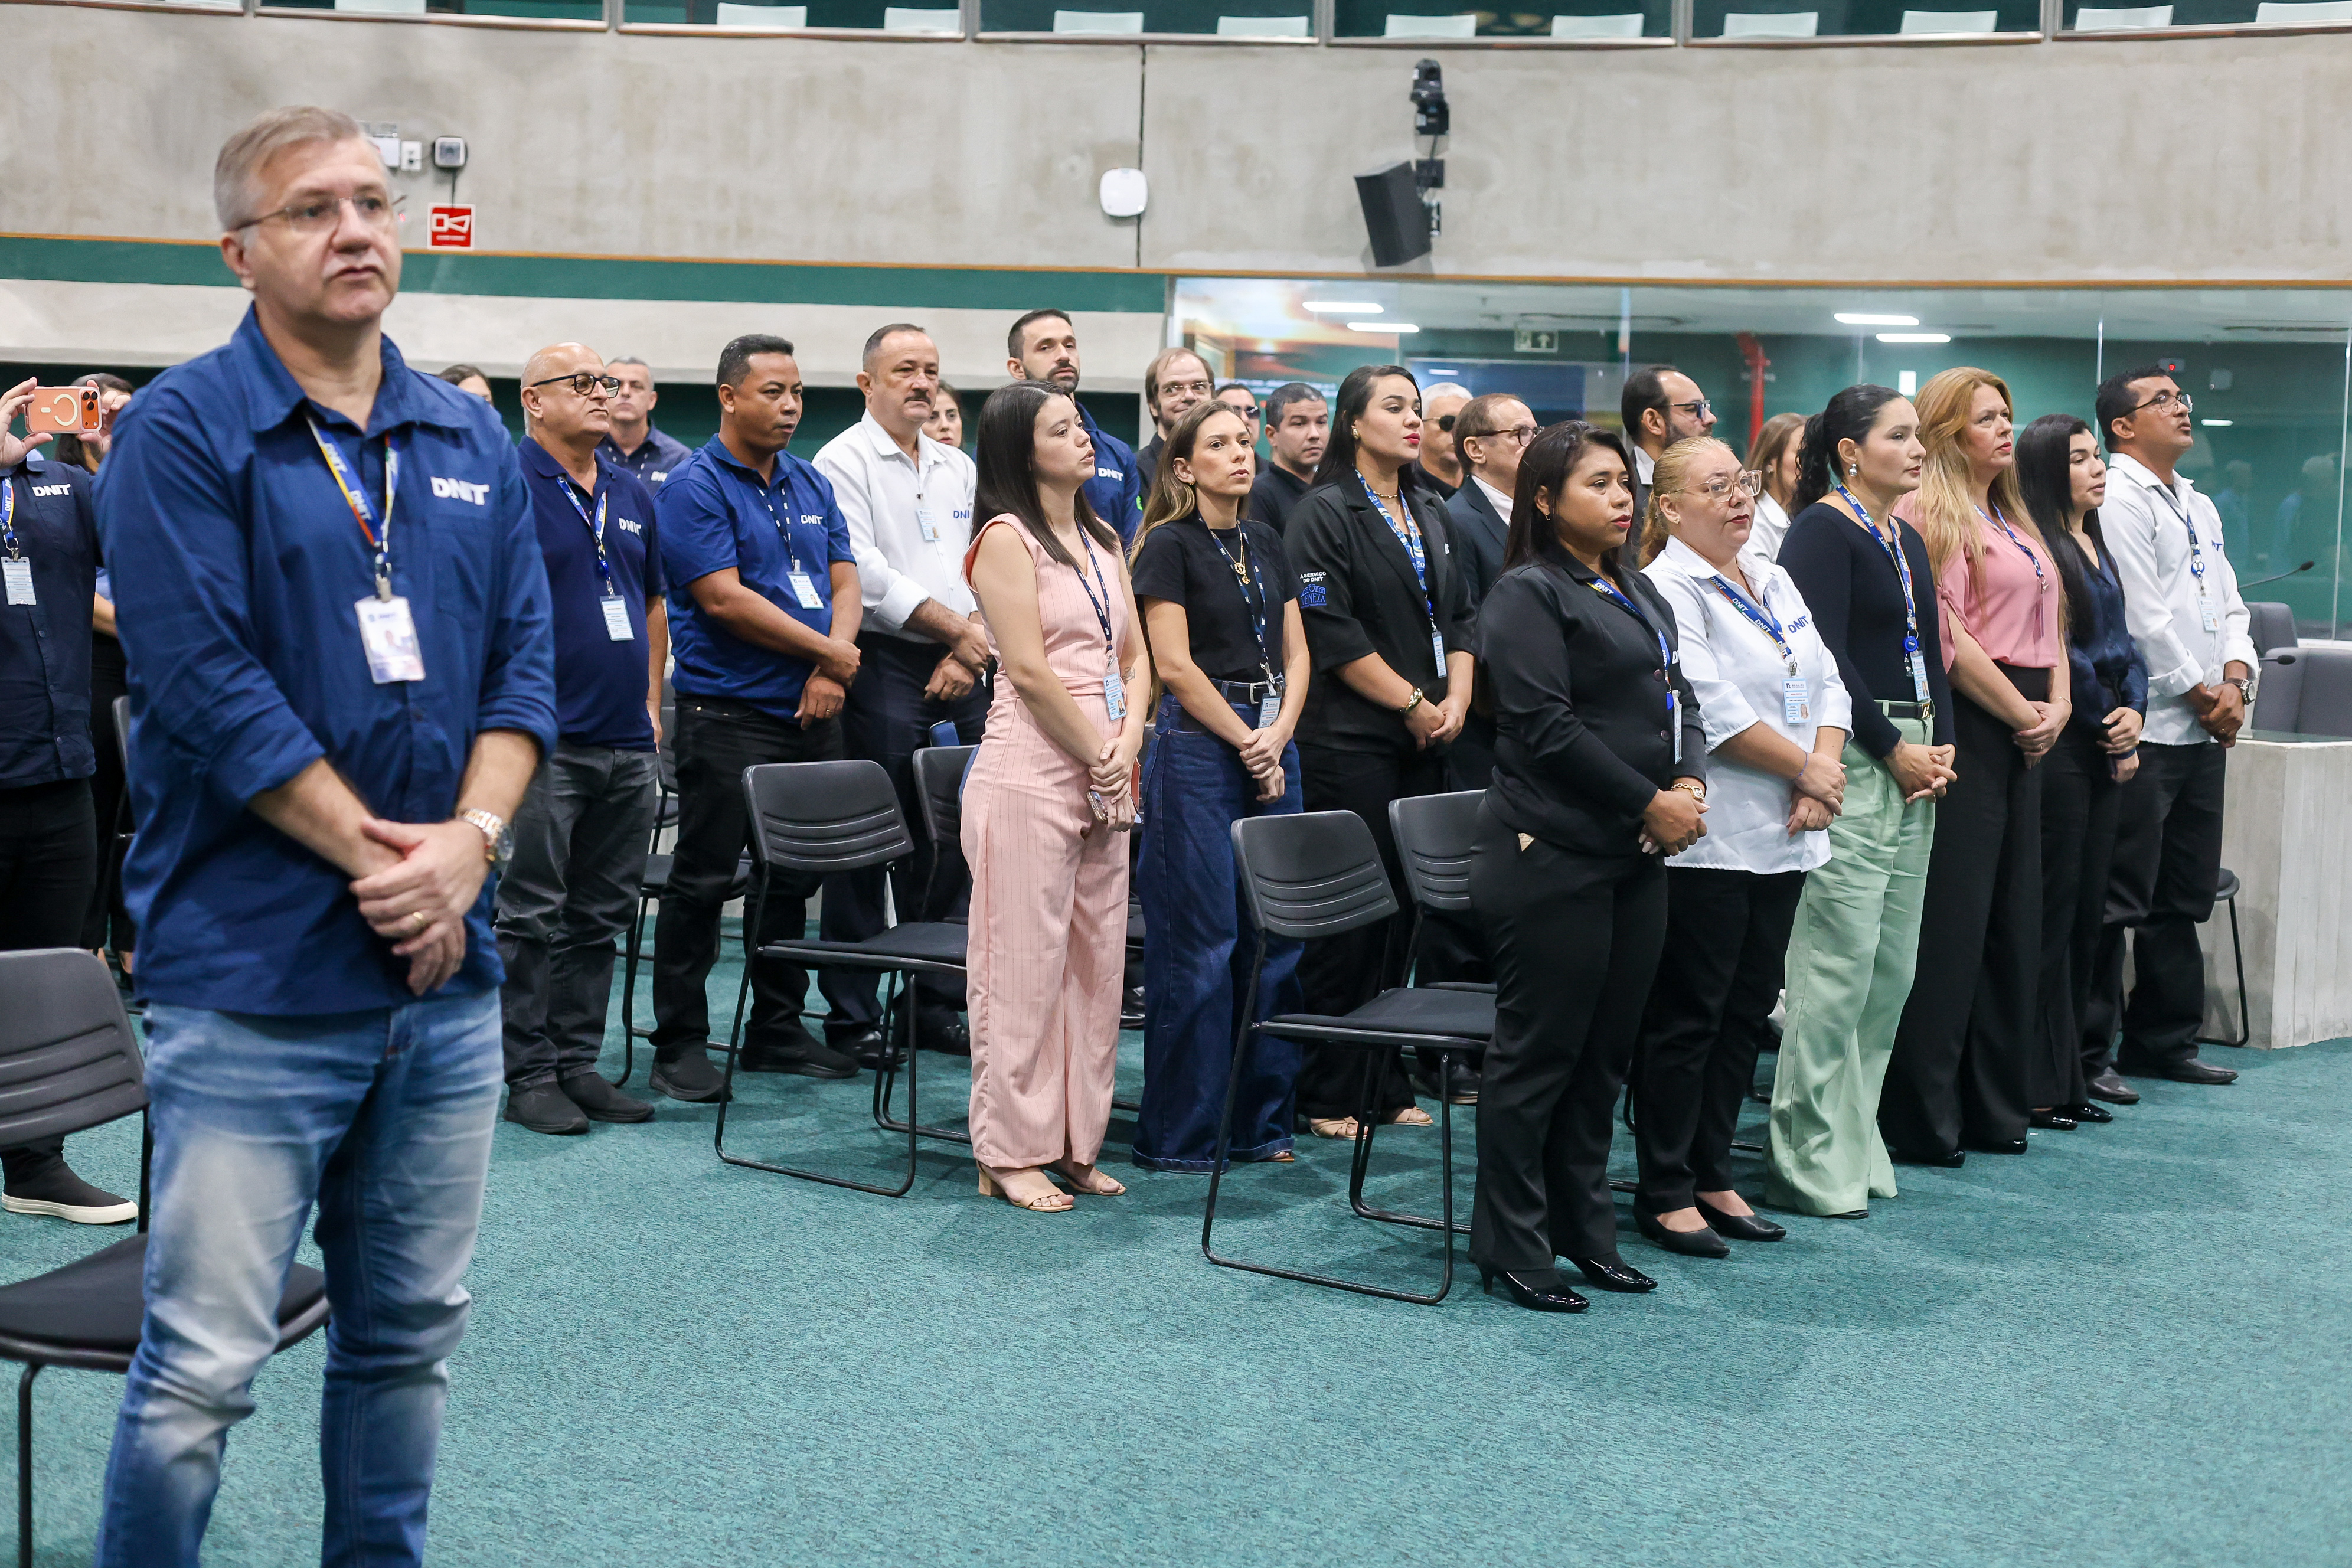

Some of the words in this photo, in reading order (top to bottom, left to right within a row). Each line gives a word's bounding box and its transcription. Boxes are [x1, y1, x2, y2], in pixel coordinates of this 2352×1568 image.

[325, 443, 348, 473] DNIT
[1098, 468, 1123, 481] DNIT
[32, 484, 71, 496] DNIT
[430, 476, 490, 505] DNIT
[349, 490, 373, 520] DNIT
[567, 492, 580, 506] DNIT
[1844, 492, 1857, 505] DNIT
[801, 515, 823, 525] DNIT
[953, 510, 969, 518] DNI
[1860, 513, 1874, 527] DNIT
[619, 518, 641, 535] DNIT
[1878, 537, 1890, 551] DNIT
[1900, 557, 1909, 572] DNIT
[1595, 582, 1614, 595] DNIT
[1710, 577, 1726, 590] DNIT
[1301, 593, 1325, 605] VENEZA
[1732, 597, 1749, 612] DNIT
[1755, 619, 1772, 633] DNIT
[1788, 615, 1809, 633] DNIT
